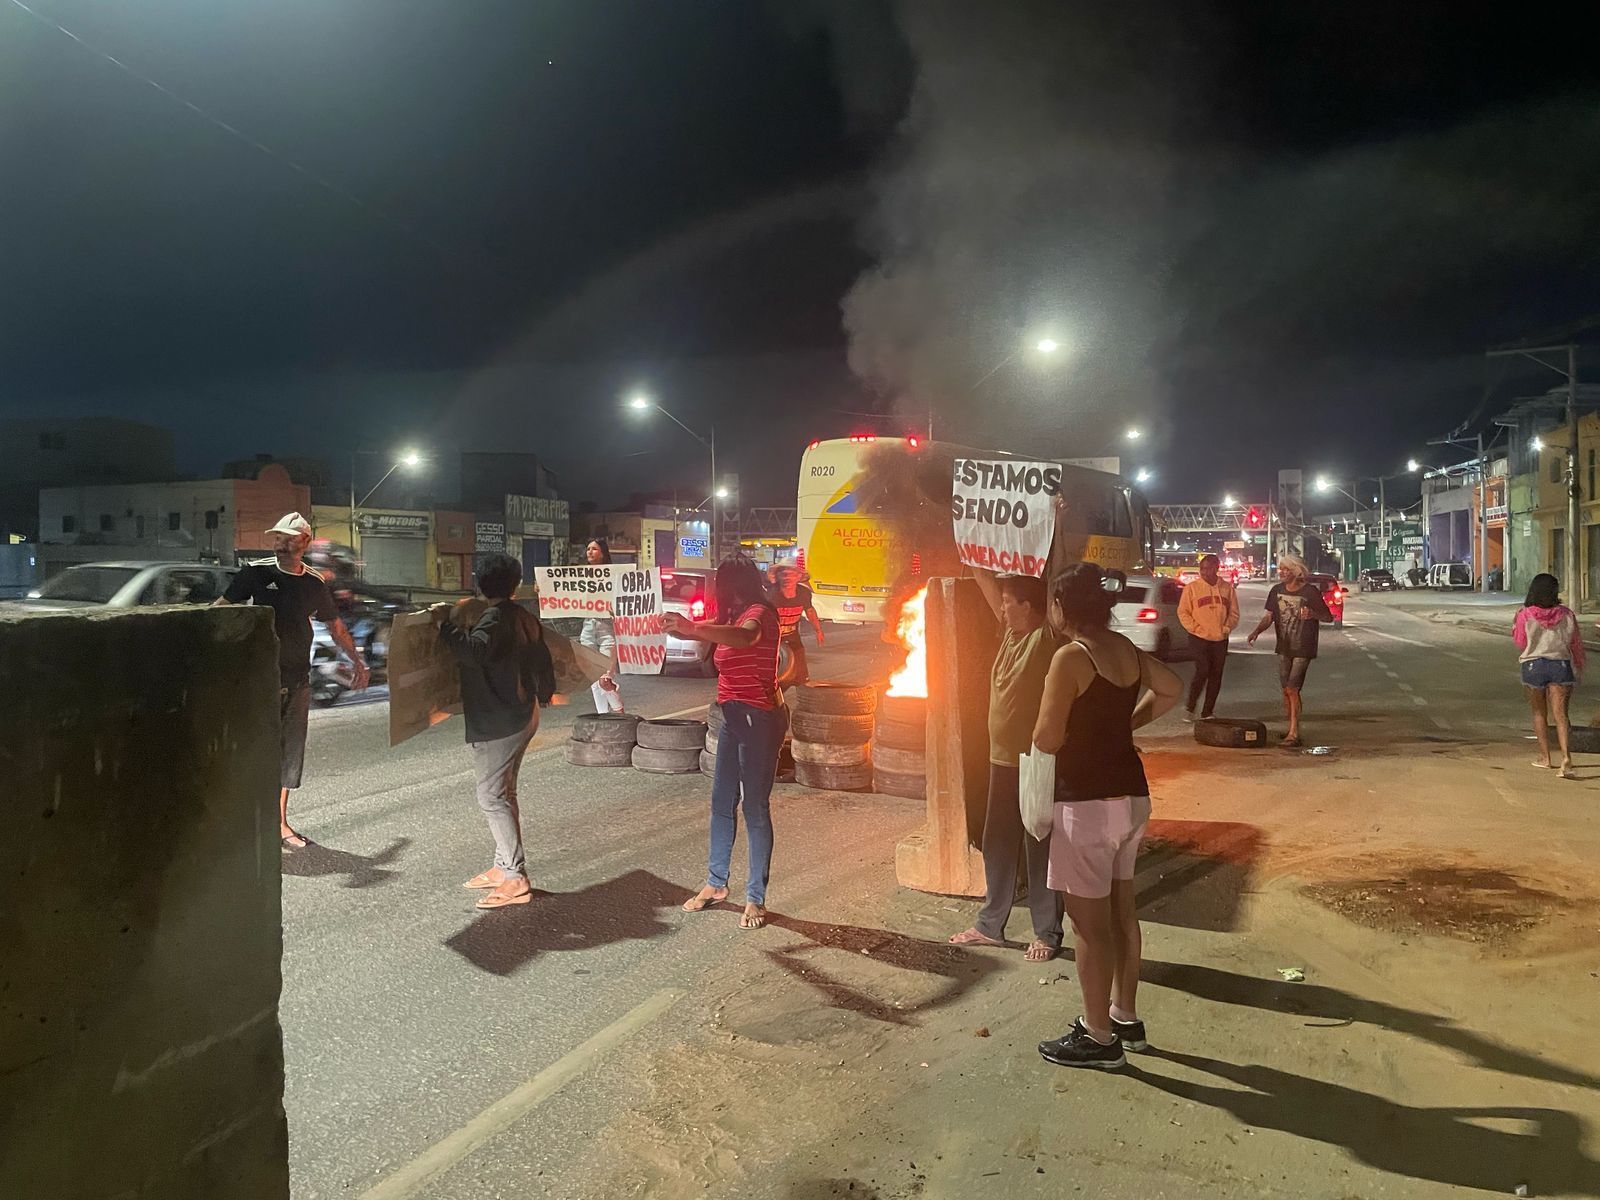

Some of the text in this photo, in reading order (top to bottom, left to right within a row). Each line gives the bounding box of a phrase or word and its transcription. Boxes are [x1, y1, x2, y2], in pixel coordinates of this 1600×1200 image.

[954, 460, 1061, 496] ESTAMOS
[952, 494, 1029, 528] SENDO
[378, 515, 422, 527] MOTORS
[475, 522, 504, 535] GESSO
[832, 528, 884, 538] ALCINO
[547, 567, 611, 579] SOFREMOS
[553, 579, 612, 593] PRESSÃO
[622, 570, 651, 593] OBRA
[616, 593, 655, 616] ETERNA
